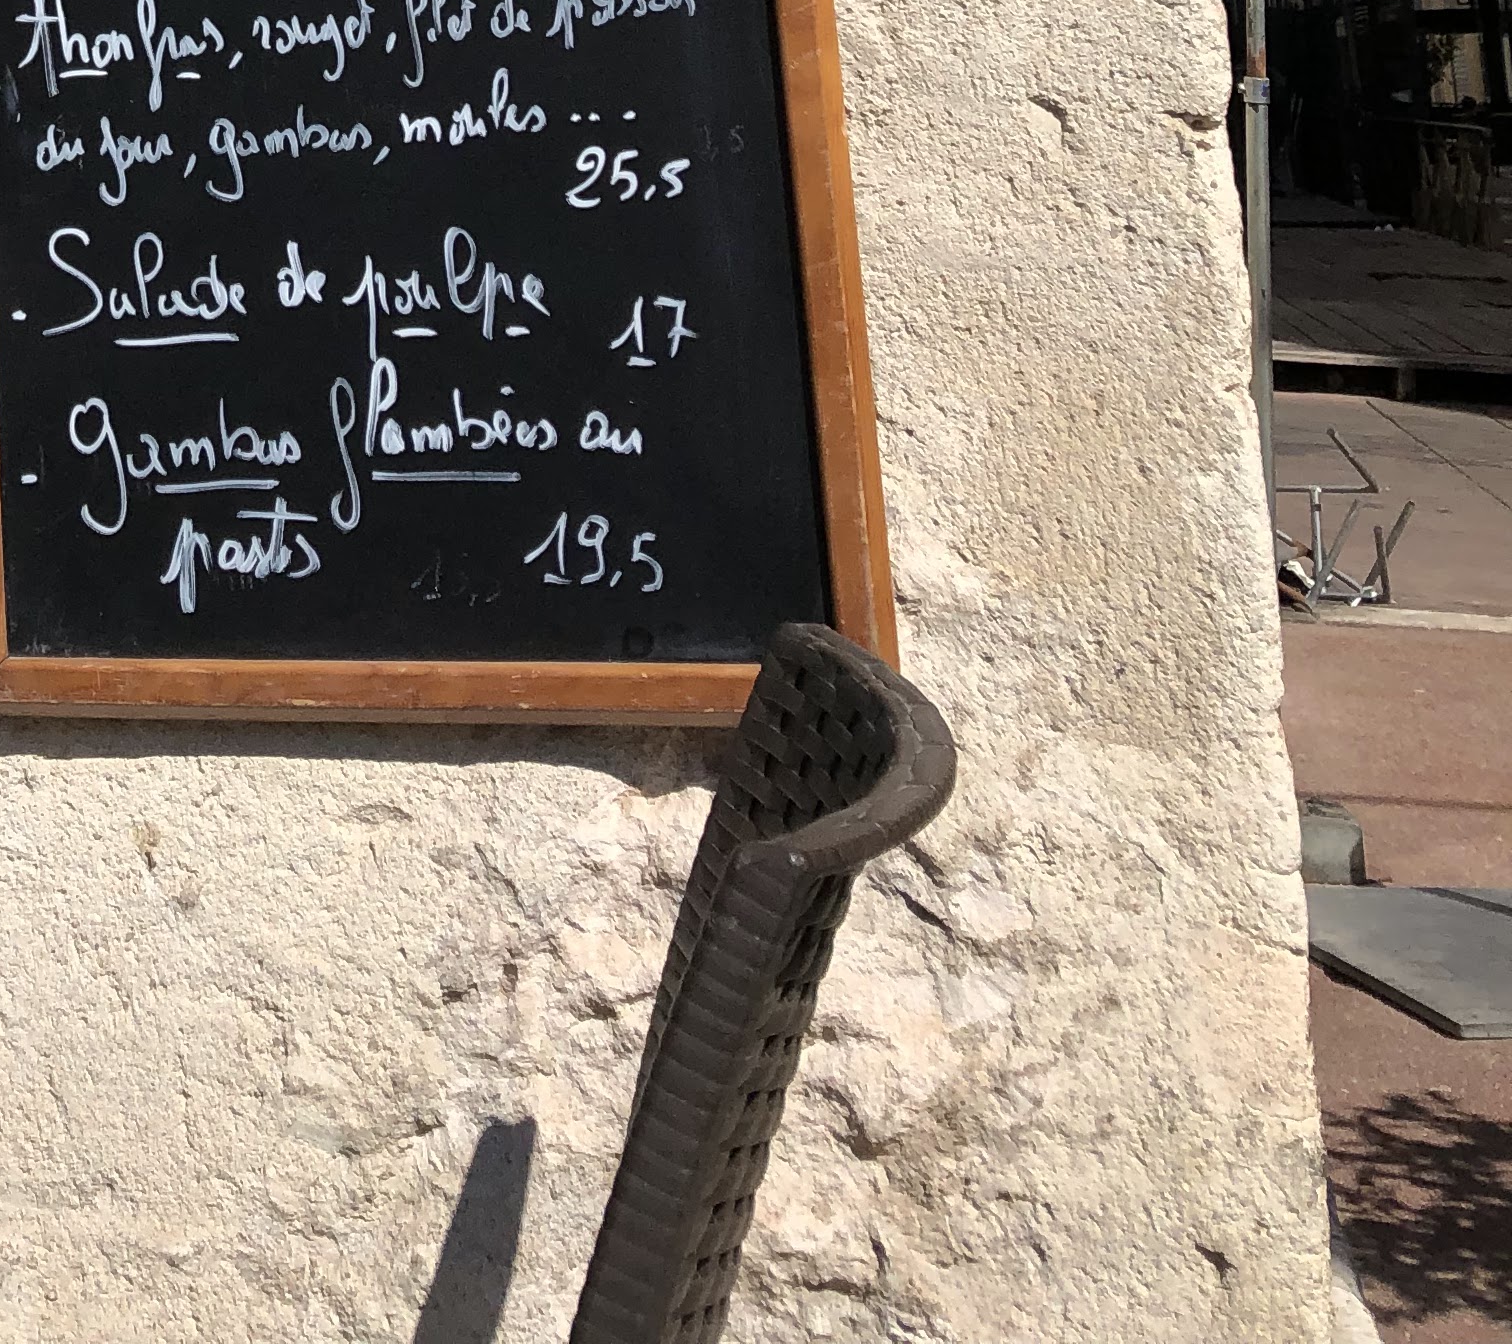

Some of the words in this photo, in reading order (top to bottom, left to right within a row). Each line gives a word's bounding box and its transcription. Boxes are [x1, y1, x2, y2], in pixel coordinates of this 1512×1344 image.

[564, 145, 691, 209] 25,5
[42, 227, 247, 338] Salade
[276, 240, 327, 309] de
[609, 296, 698, 360] 17
[578, 410, 643, 457] au
[524, 511, 666, 593] 19,5
